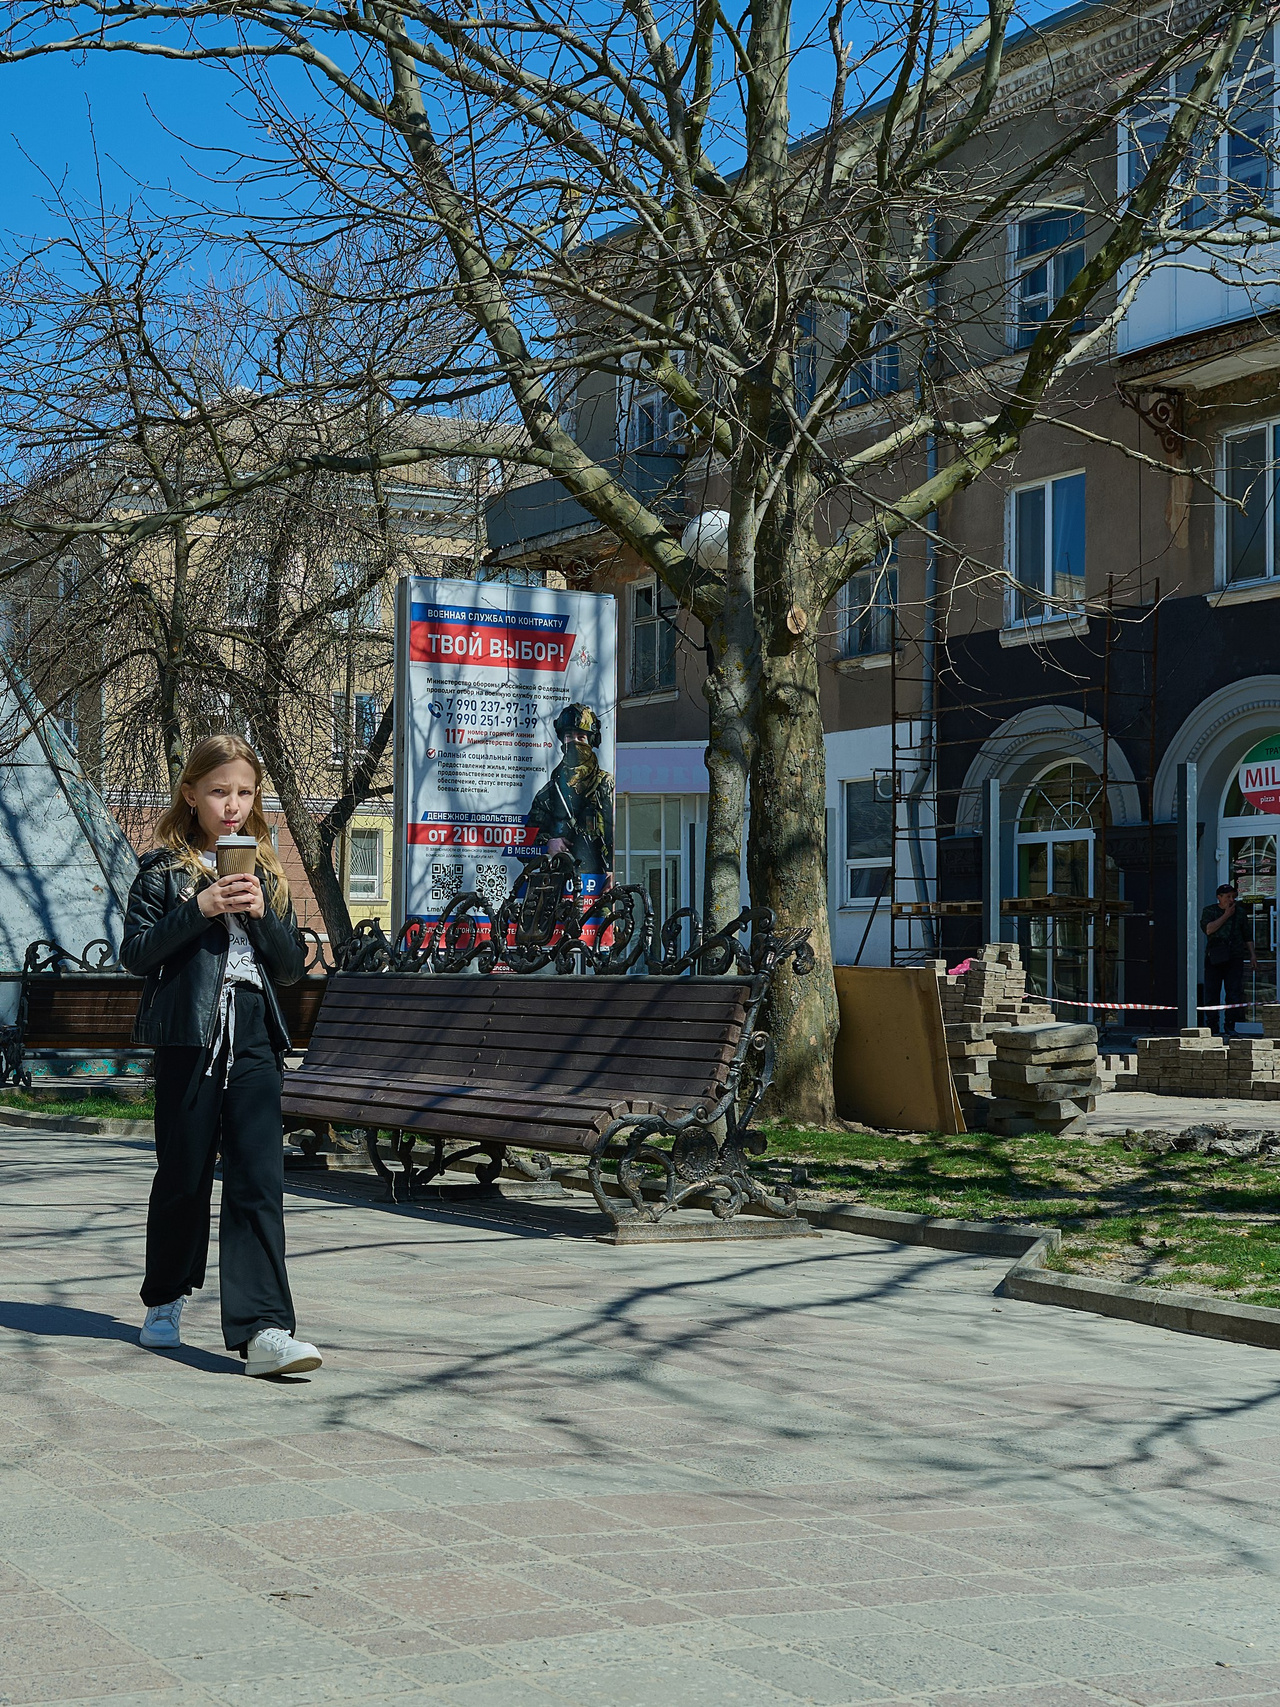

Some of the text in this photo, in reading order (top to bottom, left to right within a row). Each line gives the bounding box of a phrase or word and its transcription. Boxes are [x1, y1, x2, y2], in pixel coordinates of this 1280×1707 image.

[427, 609, 563, 628] ВОЕННАЯ СЛУЖБА ПО КОНТРАКТУ
[427, 631, 565, 663] ТВОЙ ВЫБОР!
[426, 677, 570, 693] Министерство обороны Российской Федерации
[426, 687, 456, 696] проводит
[456, 688, 475, 697] отбор
[512, 692, 533, 700] службу
[542, 694, 571, 702] контракту
[446, 698, 538, 715] 7 990 237-97-17
[446, 712, 538, 729] 7 990 251-91-99
[445, 728, 466, 744] 117
[467, 730, 488, 738] номер
[489, 731, 515, 739] горячей
[467, 737, 513, 747] Министерства
[513, 740, 542, 748] обороны
[437, 750, 533, 763] Полный социальный пакет
[437, 761, 486, 770] Предоставление
[437, 770, 495, 779] продовольственное
[437, 778, 477, 786] обеспечение,
[437, 785, 460, 793] боевых
[426, 812, 522, 823] ДЕНЕЖНОЕ ДОВОЛЬСТВИЕ
[428, 830, 448, 842] от
[452, 826, 478, 843] 210
[514, 847, 542, 855] МЕСЯЦ
